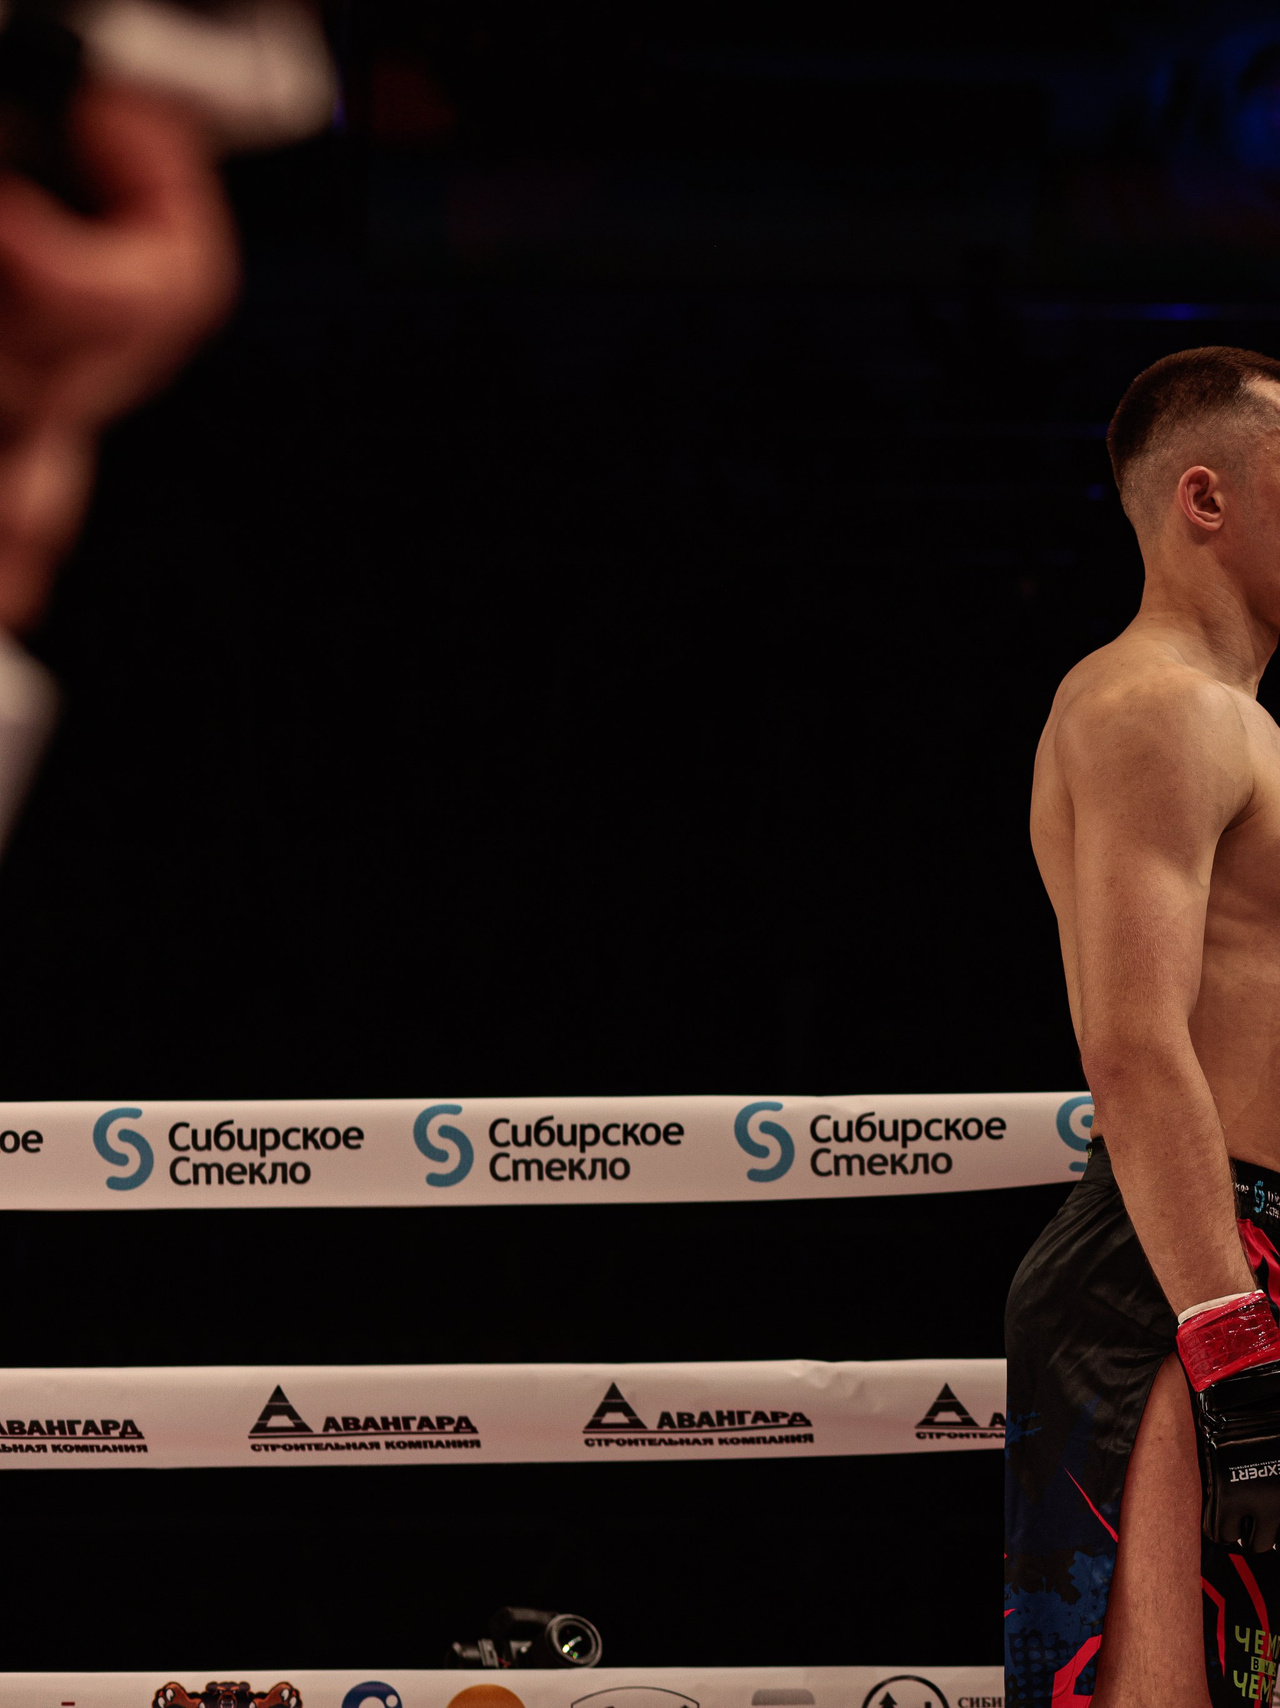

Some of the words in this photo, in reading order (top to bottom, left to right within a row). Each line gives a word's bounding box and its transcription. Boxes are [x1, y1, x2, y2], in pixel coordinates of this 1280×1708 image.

[169, 1120, 364, 1157] Сибирское
[489, 1116, 685, 1153] Сибирское
[810, 1112, 1007, 1149] Сибирское
[169, 1156, 311, 1186] Стекло
[489, 1152, 631, 1182] Стекло
[810, 1147, 953, 1177] Стекло
[322, 1416, 479, 1434] АВАНГАРД
[656, 1410, 813, 1429] АВАНГАРД
[51, 1444, 148, 1453] КОМПАНИЯ
[250, 1441, 381, 1452] СТРОИТЕЛЬНАЯ
[384, 1439, 481, 1449] КОМПАНИЯ
[584, 1437, 714, 1447] СТРОИТЕЛЬНАЯ
[717, 1433, 814, 1445] КОМПАНИЯ
[1233, 1670, 1276, 1703] ЧЕМ
